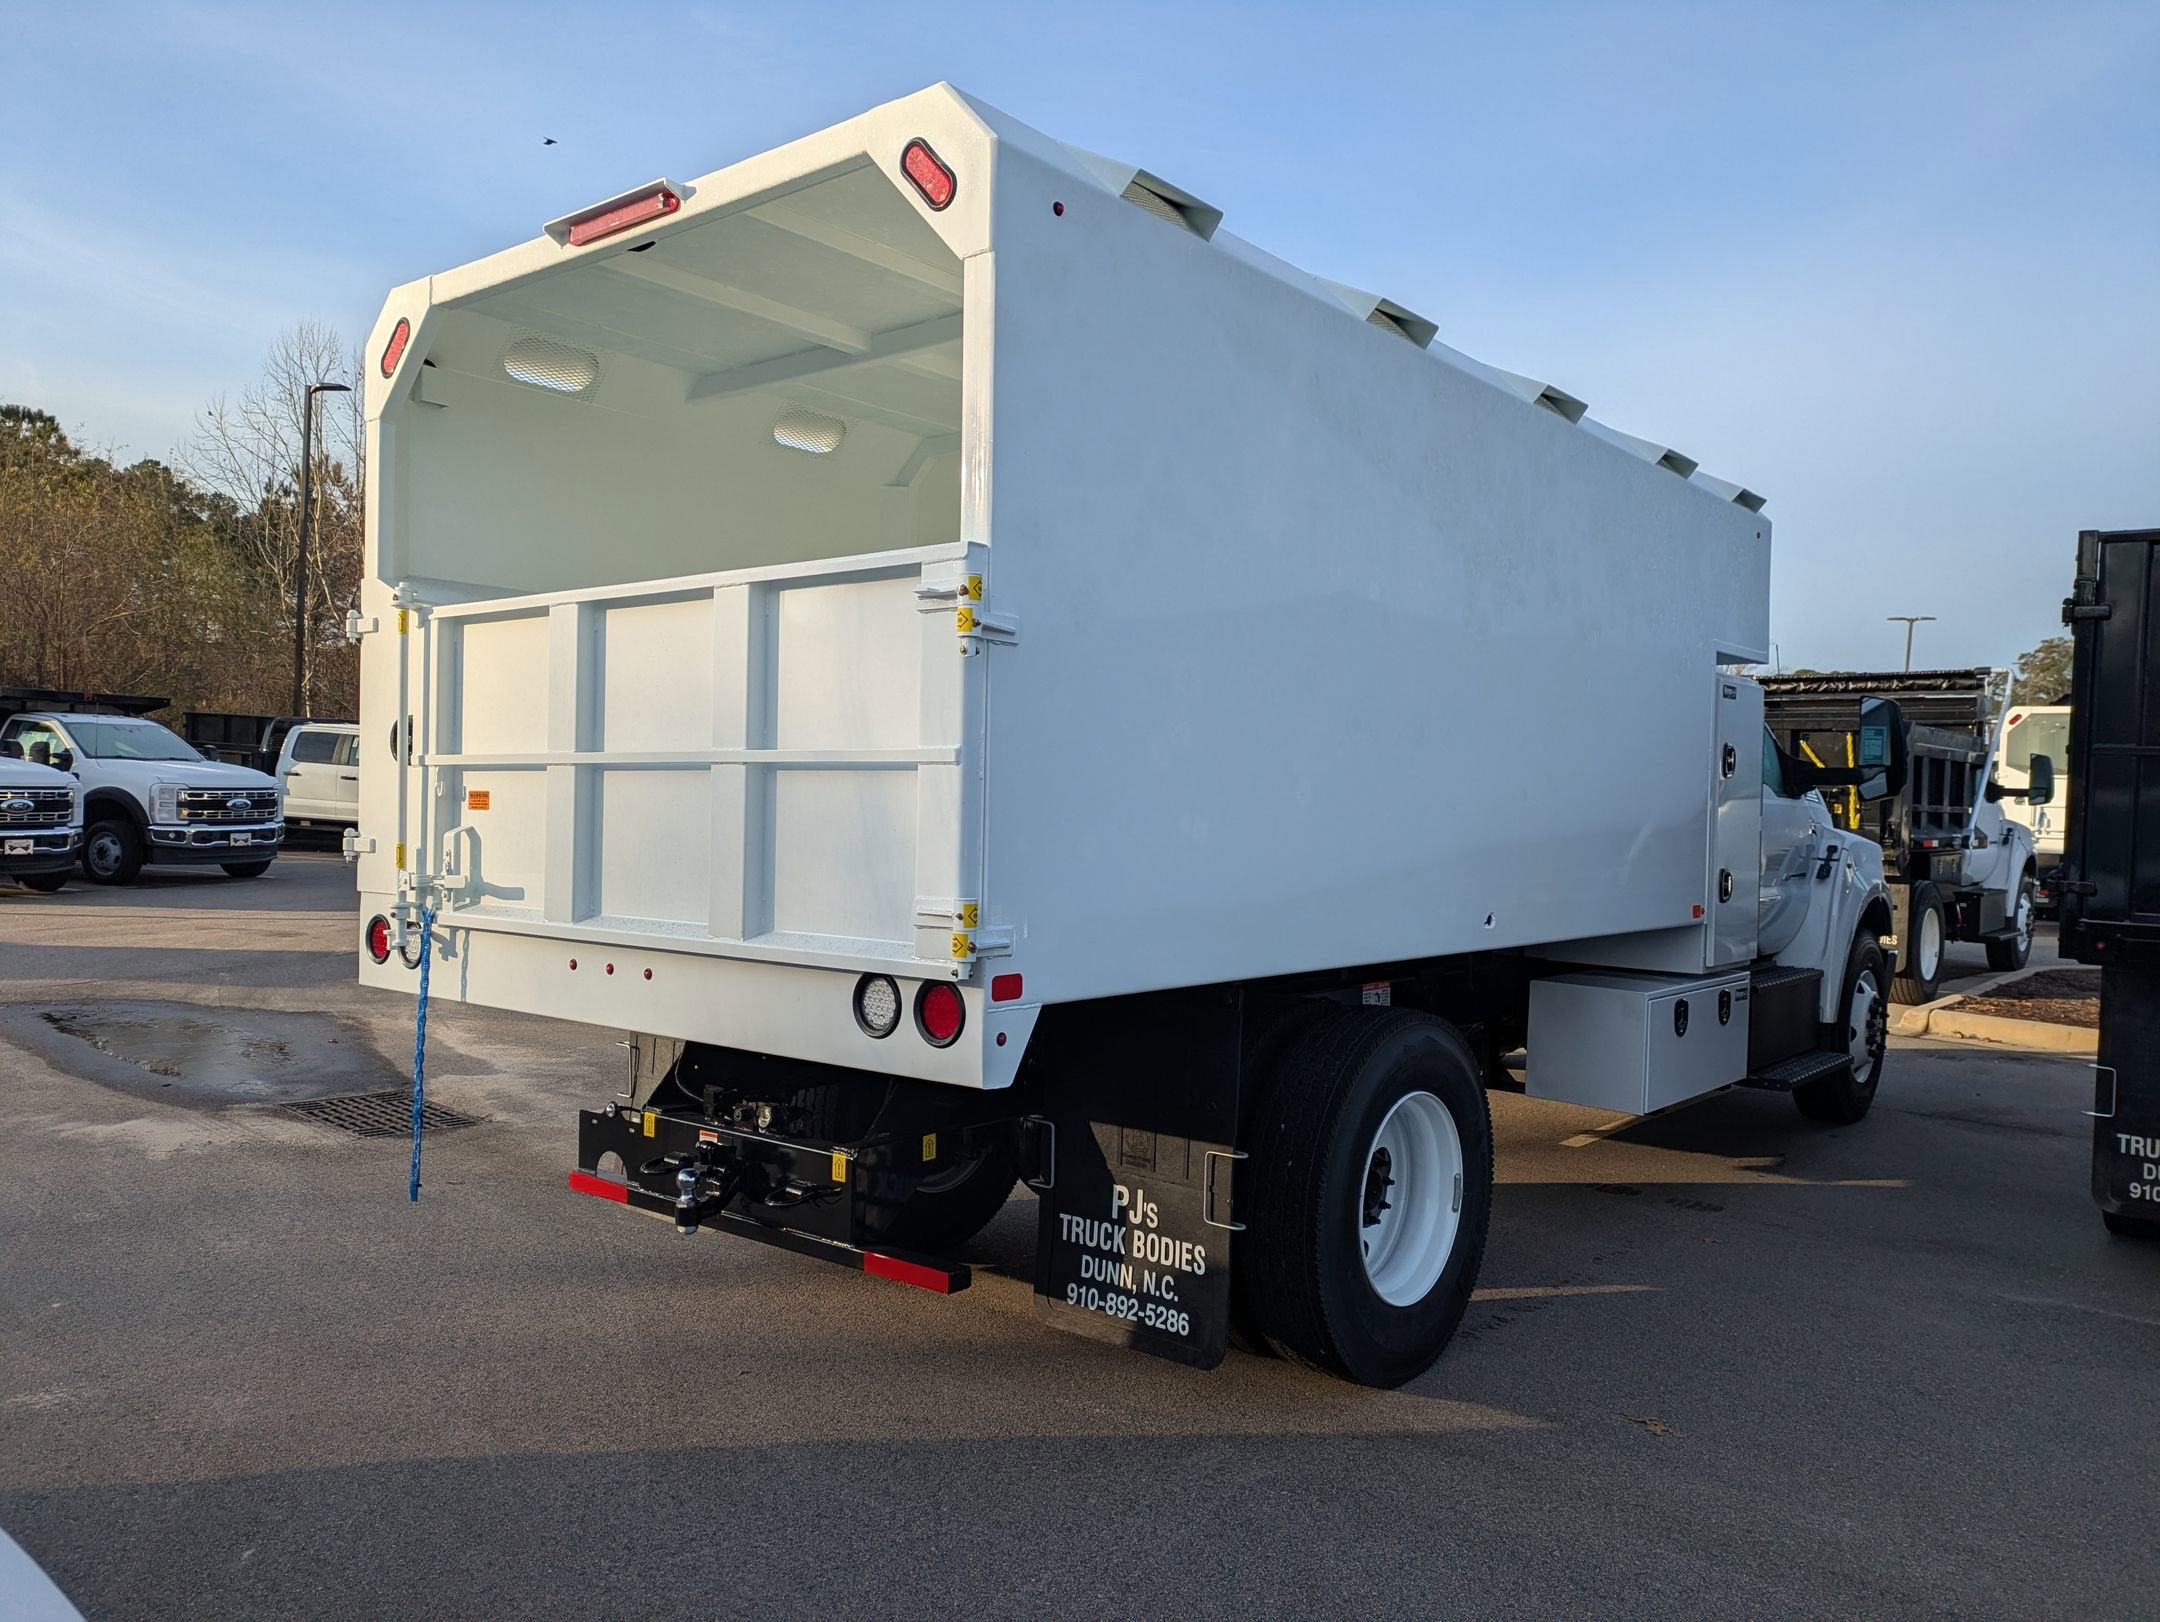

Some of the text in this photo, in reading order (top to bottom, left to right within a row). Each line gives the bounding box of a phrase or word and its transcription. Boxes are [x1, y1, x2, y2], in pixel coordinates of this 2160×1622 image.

[1059, 1213, 1206, 1276] TRUCK BODIES
[1080, 1254, 1179, 1302] DUNN, N.C.
[1066, 1282, 1190, 1336] 910-892-5286
